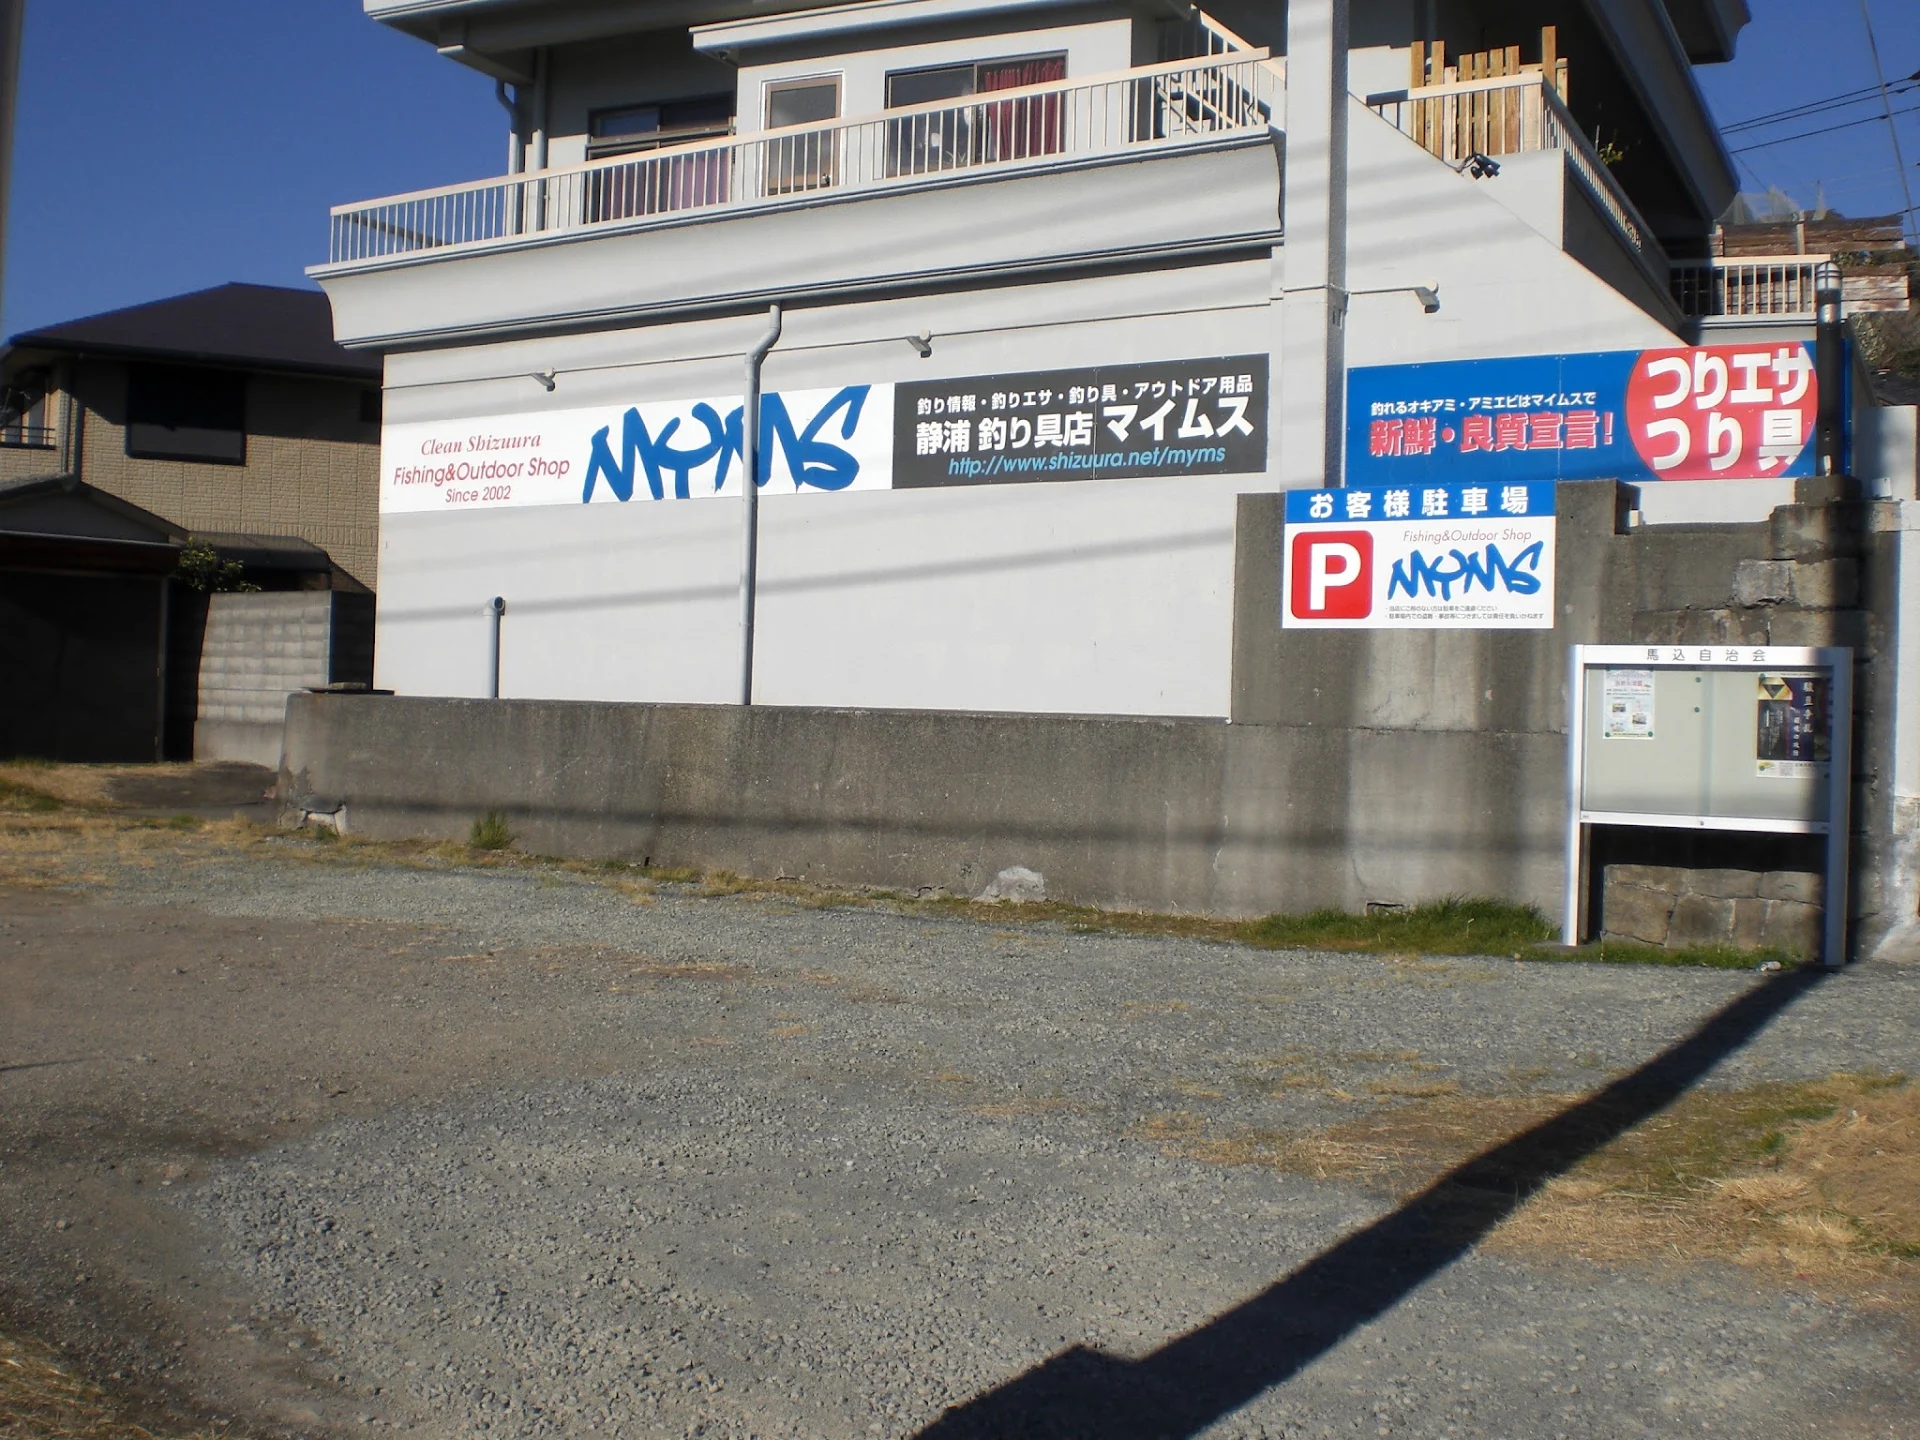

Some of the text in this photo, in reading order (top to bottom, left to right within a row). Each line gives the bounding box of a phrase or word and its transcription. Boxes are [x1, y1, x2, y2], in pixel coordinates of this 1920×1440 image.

[1647, 347, 1814, 410] つりエサ
[916, 397, 1254, 455] 静浦 釣り具店 マイムス
[1646, 409, 1805, 471] つり具
[421, 432, 541, 455] Clean Shizuura
[394, 456, 570, 486] Fishing&Outdoor Shop
[948, 446, 1225, 478] http://www.shizuura.net/myms
[445, 485, 511, 503] Since 2002
[1309, 486, 1528, 519] お客様駐車場
[1403, 529, 1531, 544] Fishing&Outdoor Shop
[1310, 542, 1361, 610] P
[1647, 648, 1766, 662] 馬込自治会
